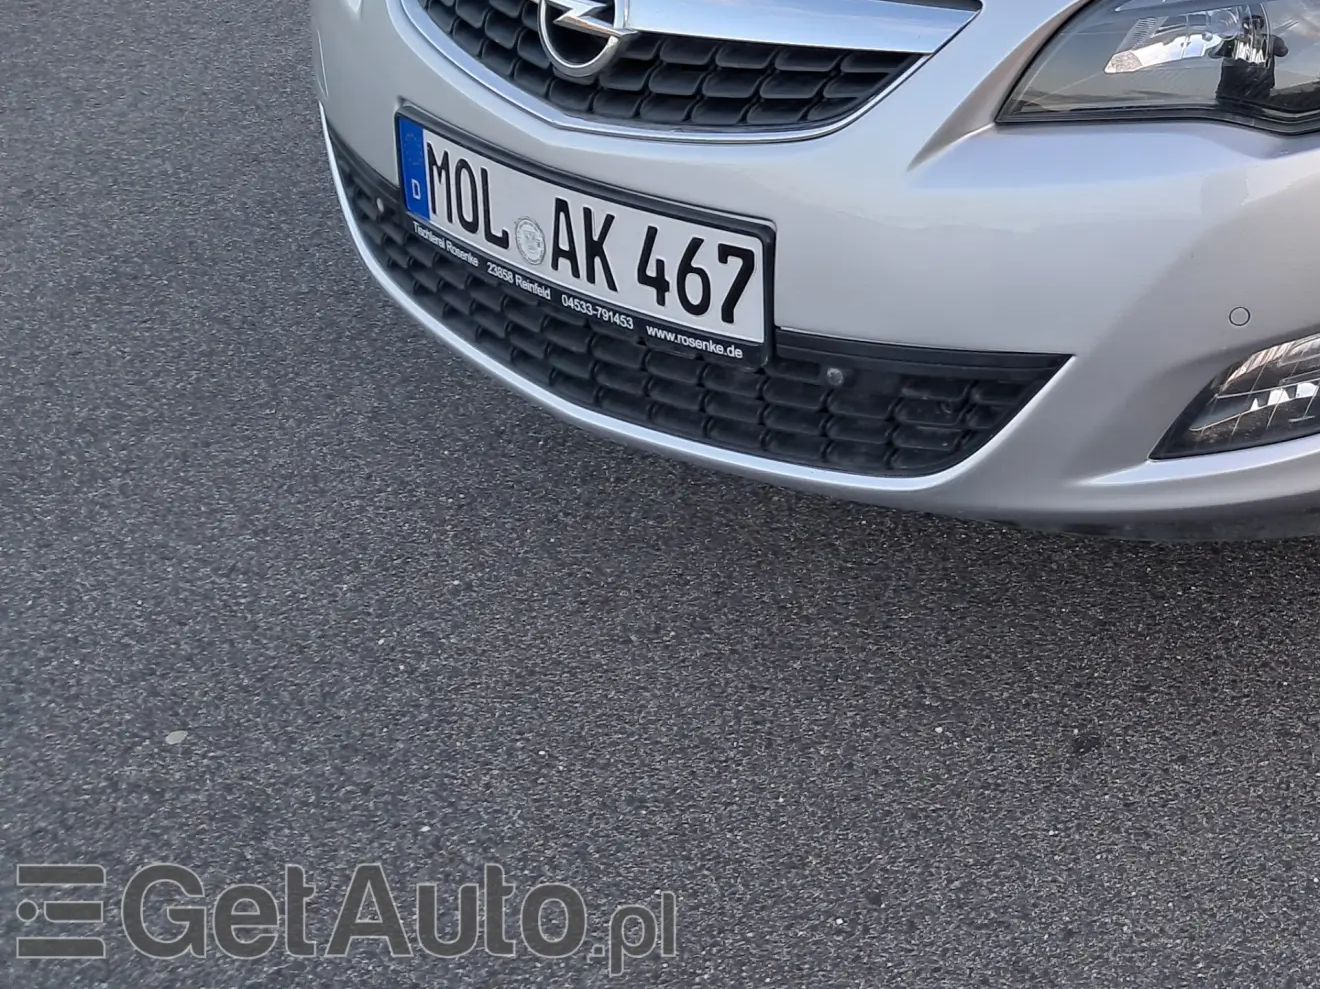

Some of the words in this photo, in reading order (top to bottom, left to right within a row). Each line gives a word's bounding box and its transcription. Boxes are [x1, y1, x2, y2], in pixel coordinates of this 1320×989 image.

[411, 178, 421, 200] D
[427, 141, 510, 250] MOL
[551, 197, 618, 292] AK
[637, 225, 755, 325] 467
[446, 240, 479, 267] Rosenke
[486, 262, 513, 283] 23858
[515, 274, 551, 300] Reinfeld
[561, 294, 634, 329] 04533-791453
[646, 325, 743, 359] www.rosenke.de
